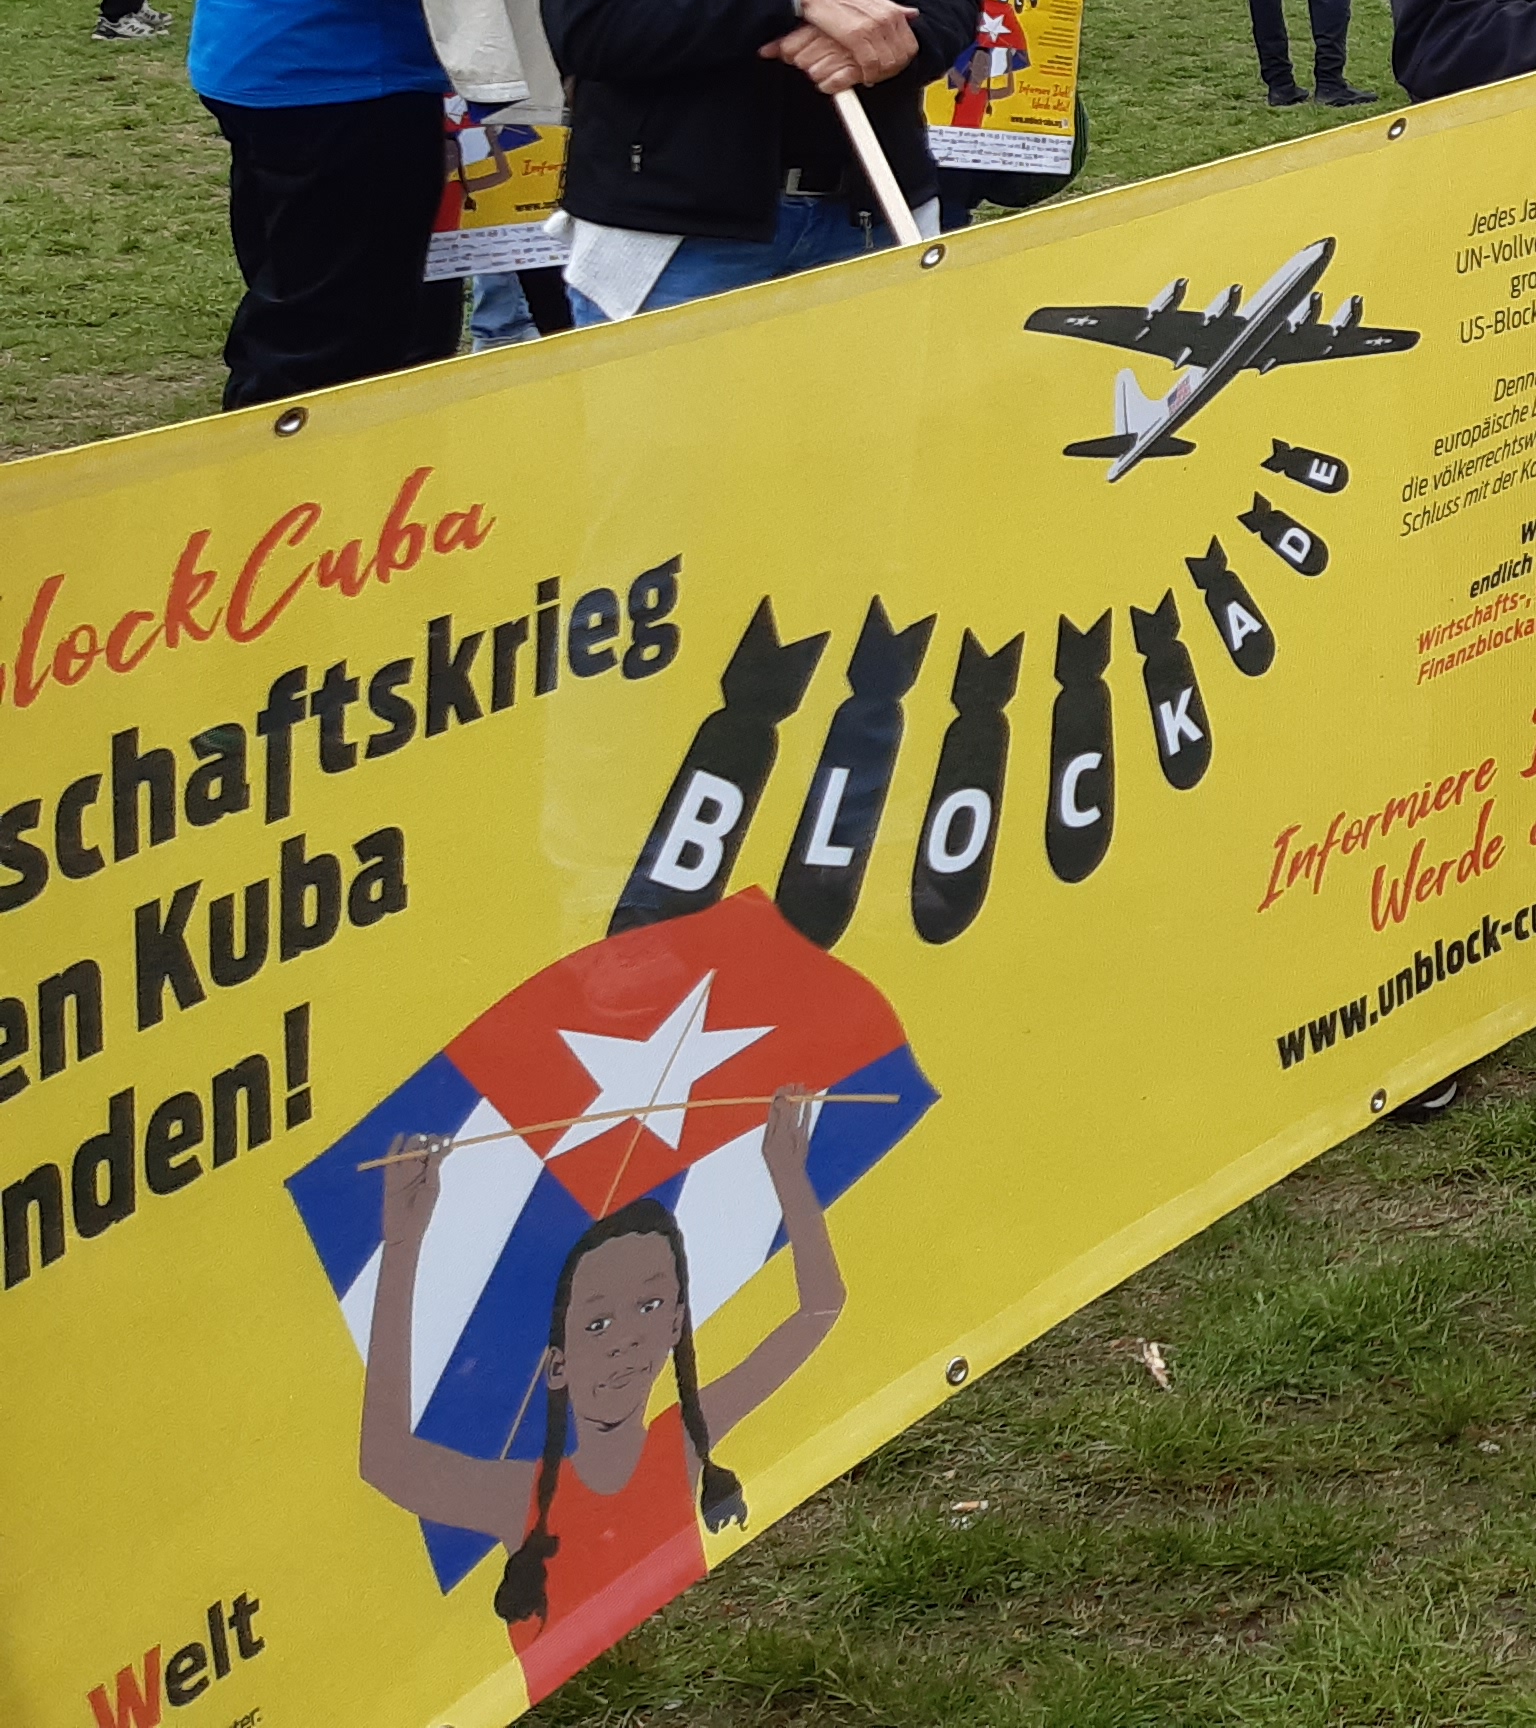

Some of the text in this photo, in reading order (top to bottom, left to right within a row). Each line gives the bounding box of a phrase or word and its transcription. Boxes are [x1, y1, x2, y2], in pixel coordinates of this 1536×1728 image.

[1467, 207, 1516, 237] Jedes
[1433, 403, 1529, 457] europäische
[1400, 493, 1461, 537] Schluss
[1462, 481, 1490, 509] mit
[1492, 469, 1518, 496] der
[1401, 476, 1429, 503] die
[1469, 553, 1533, 598] endlich
[1417, 592, 1532, 654] Wirtschafts-,
[649, 457, 1339, 893] BLOCKADE
[1257, 757, 1499, 914] Informiere
[1369, 798, 1505, 933] Werde
[134, 826, 408, 1033] Kuba
[86, 1591, 266, 1728] Welt
